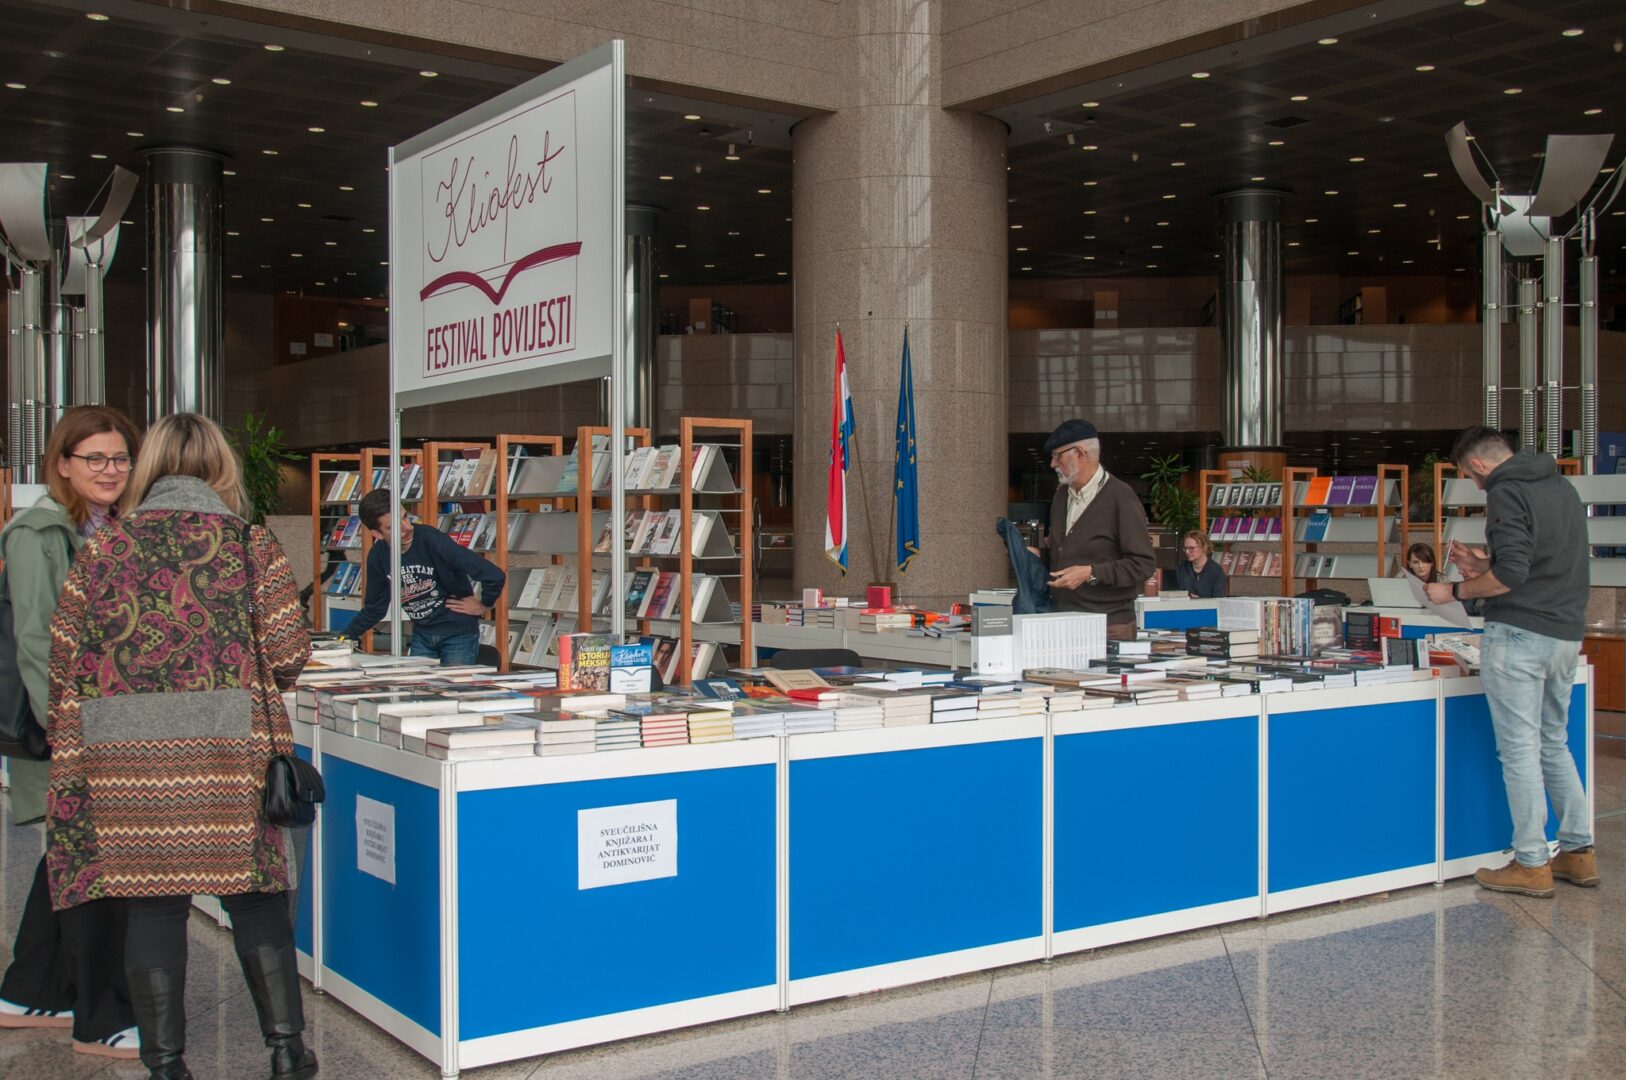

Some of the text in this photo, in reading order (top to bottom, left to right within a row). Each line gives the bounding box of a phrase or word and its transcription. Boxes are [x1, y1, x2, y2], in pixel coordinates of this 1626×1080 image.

[427, 129, 566, 264] Kliofest
[427, 294, 572, 371] FESTIVAL POVIJESTI
[600, 822, 658, 838] SVEUČILIŠNA
[605, 835, 648, 848] KNJIŽARA
[598, 843, 661, 859] ANTIKVARIJAT
[603, 854, 656, 869] DOMINOVIĆ
